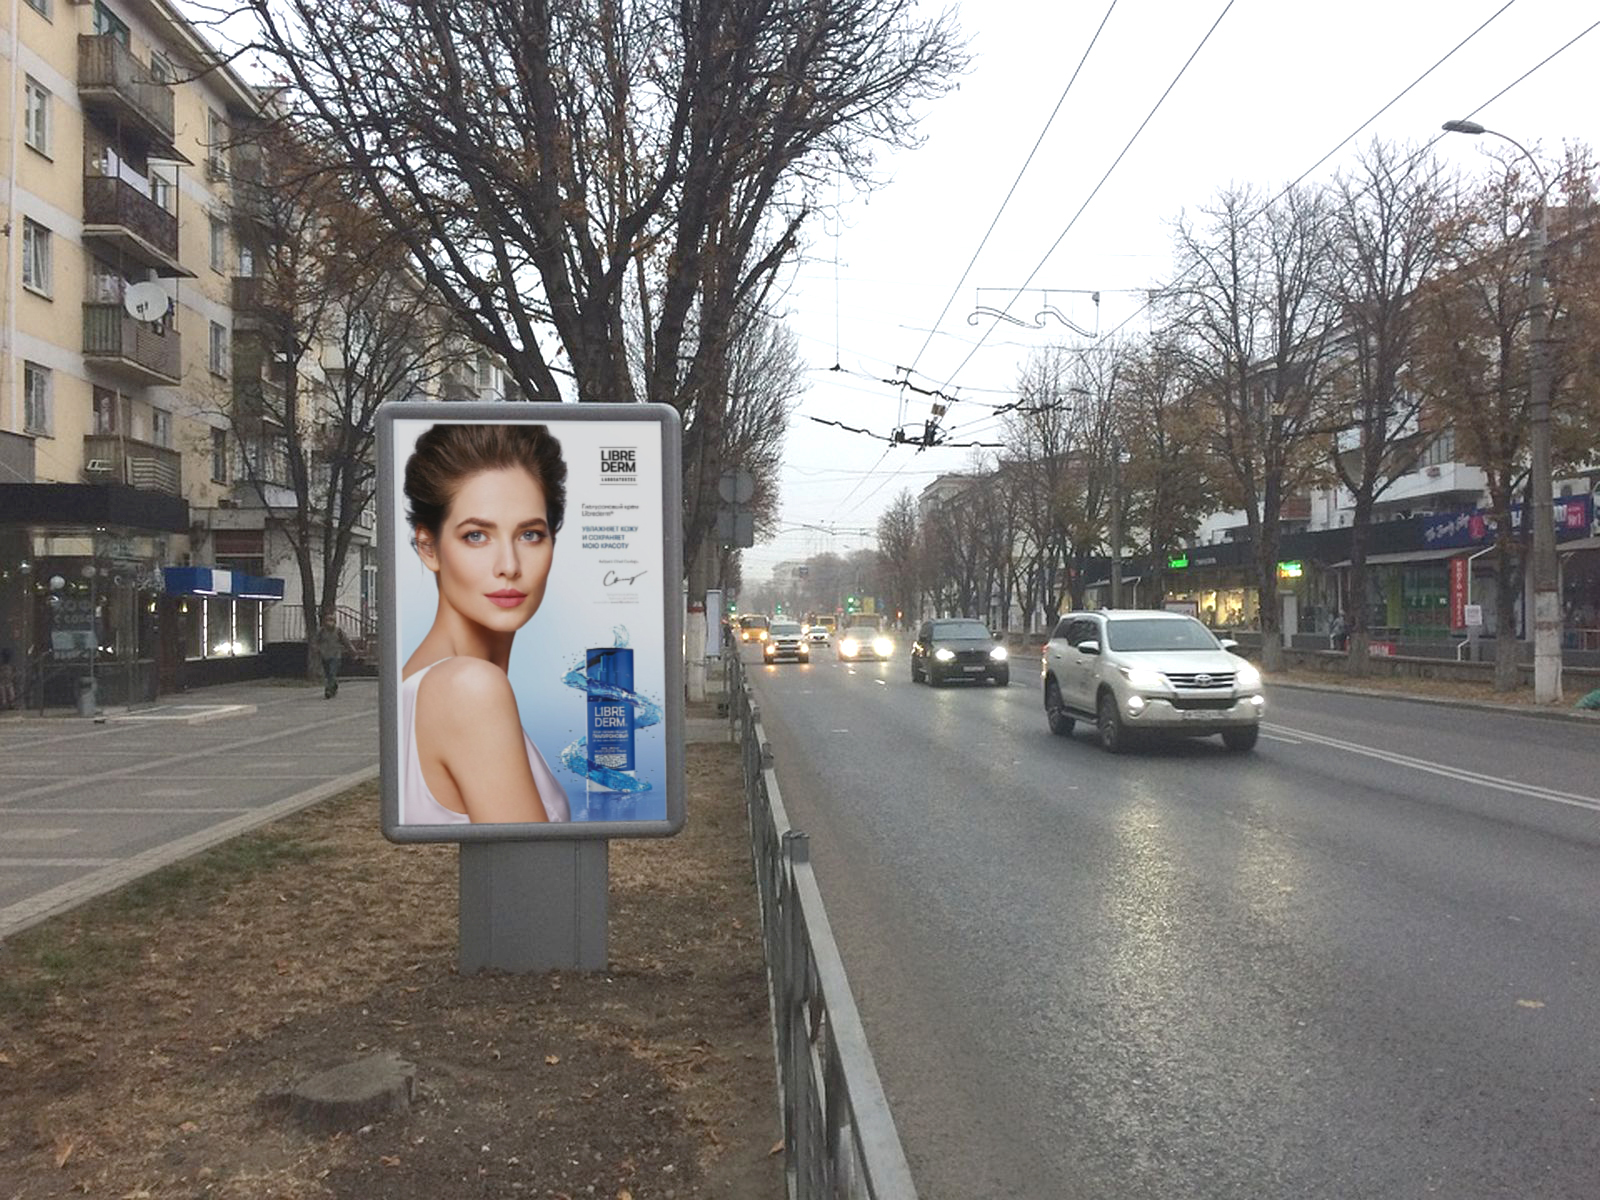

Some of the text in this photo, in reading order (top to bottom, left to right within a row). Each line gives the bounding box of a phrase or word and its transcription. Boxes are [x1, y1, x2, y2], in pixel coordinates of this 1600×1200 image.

[601, 449, 636, 461] LIBRE
[601, 461, 636, 473] DERM
[594, 706, 625, 716] LIBRE
